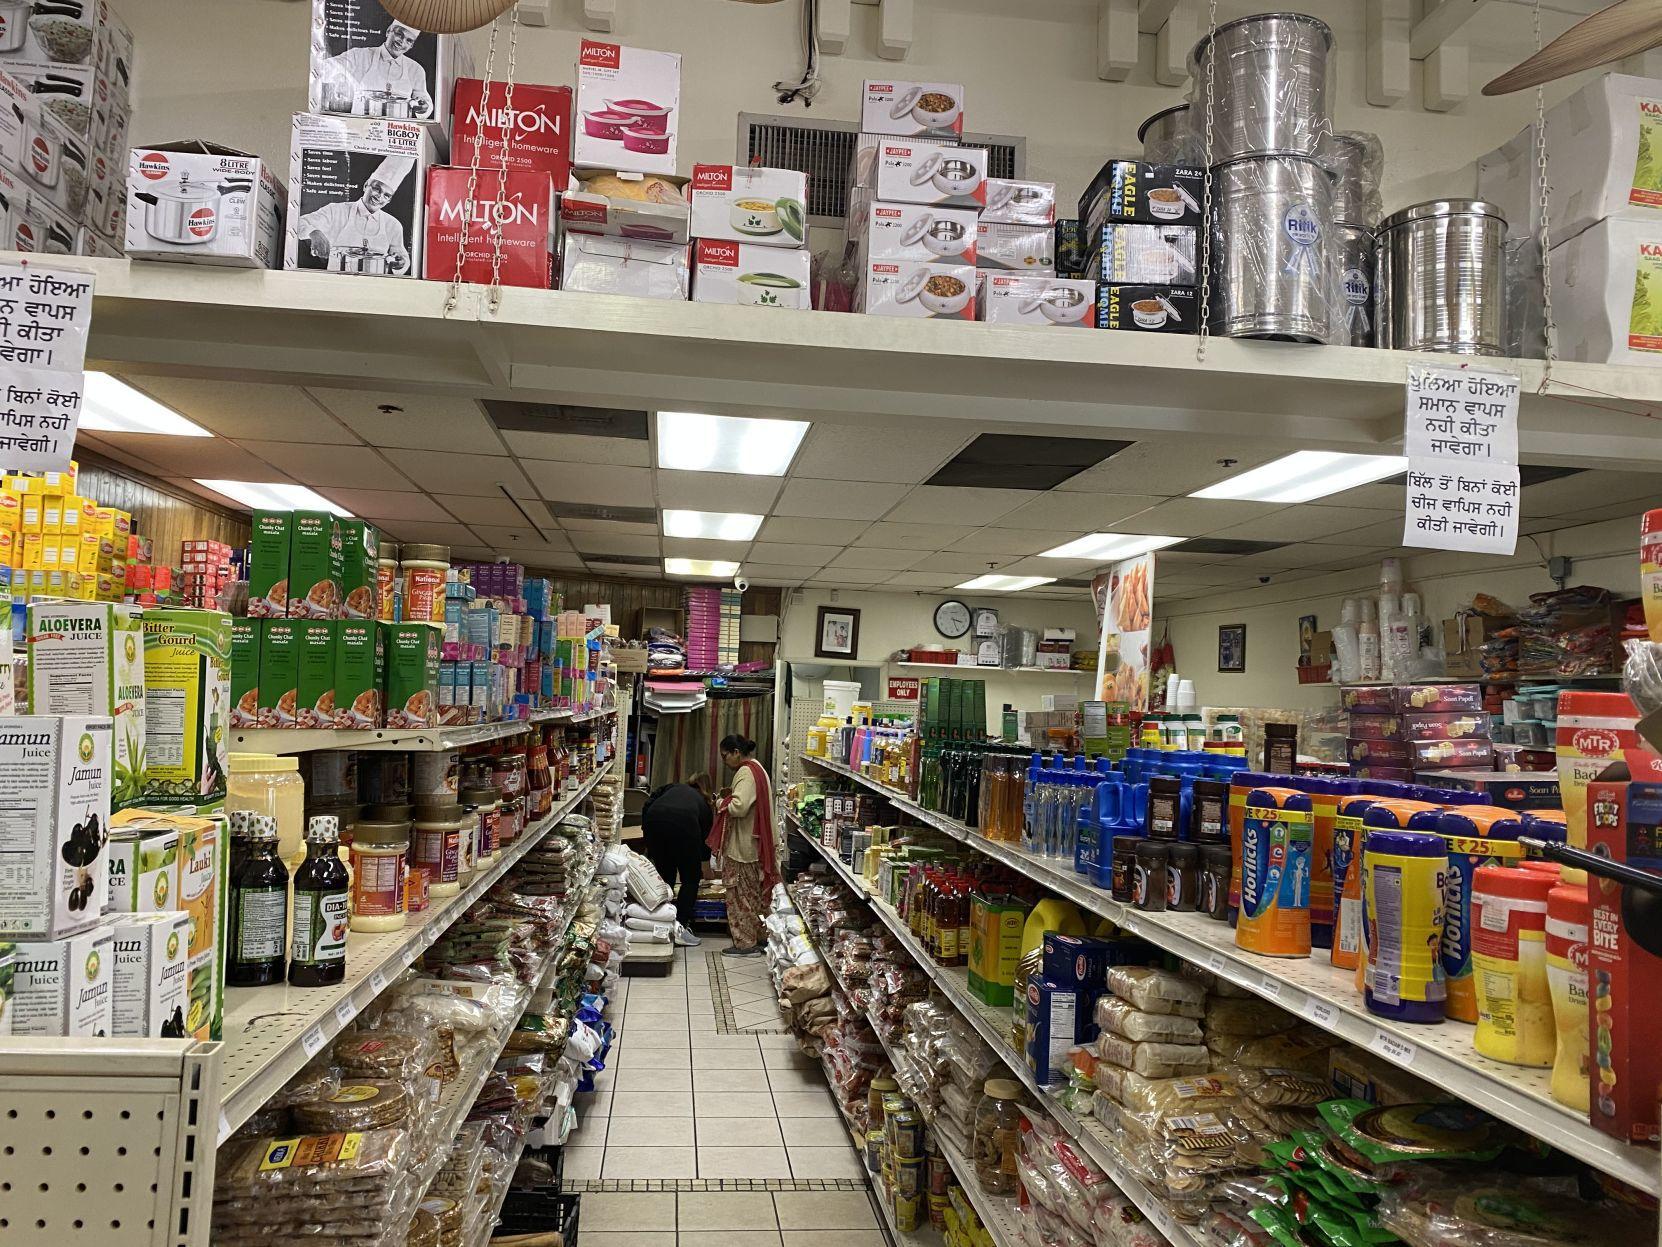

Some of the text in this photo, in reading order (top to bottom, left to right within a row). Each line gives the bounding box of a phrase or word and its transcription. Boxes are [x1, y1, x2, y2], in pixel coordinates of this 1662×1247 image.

[582, 47, 615, 58] MILTON
[387, 122, 421, 133] Hawkins
[466, 105, 560, 136] MILTON
[387, 130, 420, 139] BIGBOY
[511, 140, 559, 155] homeware
[139, 162, 170, 171] Hawkins
[220, 158, 249, 169] 8 LITRE
[212, 167, 256, 176] WIDE-BODY
[697, 172, 727, 180] MILTON
[1175, 168, 1193, 177] ZARA
[1111, 163, 1123, 216] HOME
[1123, 162, 1136, 216] EAGLE
[188, 218, 215, 227] Hawkins
[1288, 219, 1317, 234] Ritik
[466, 251, 491, 259] ORCHID
[704, 248, 735, 257] MILTON
[1114, 226, 1127, 281] EAGLE
[29, 274, 89, 299] ਹੋਇਆ
[24, 301, 77, 321] ਵਾਪਸ
[1110, 287, 1120, 329] EAGLE
[17, 320, 64, 342] ਕੀਤਾ
[1468, 377, 1518, 399] ਹੋਇਆ
[7, 385, 80, 409] ਬਿਨਾਂ ਕੋਈ
[1419, 396, 1506, 418] ਸਮਾਨ ਵਾਪਸ
[1460, 418, 1498, 437] ਕੀਤਾ
[1408, 472, 1518, 496] ਬਿੱਲ ਤੋਂ ਬਿਨਾਂ ਕੋਈ
[1411, 494, 1438, 510] ਚੀਜ
[1442, 498, 1482, 514] ਵਾਪਿਸ
[1417, 516, 1449, 532] ਕੀਤੀ
[415, 575, 440, 583] National
[39, 618, 101, 632] ALOEVERA
[143, 622, 175, 633] Bitter
[70, 633, 102, 641] JUICE
[158, 633, 196, 645] Gourd
[118, 685, 144, 700] ALOEVERA
[1459, 695, 1474, 703] Papdi
[0, 733, 51, 746] amun
[1579, 735, 1611, 751] MTR
[22, 747, 51, 759] Juice
[68, 766, 102, 786] Jamun
[1574, 768, 1598, 781] Bad
[89, 780, 102, 791] Juice
[1529, 785, 1549, 794] Soan
[1594, 801, 1619, 816] FROOT
[1595, 813, 1618, 827] LOOPS
[189, 853, 211, 874] Lauki
[1244, 828, 1258, 905] Horlicks
[1443, 865, 1463, 960] Horlicks
[1593, 920, 1618, 934] EVERY
[1593, 932, 1618, 949] BITE
[15, 959, 59, 973] mun
[114, 954, 142, 965] Juice
[29, 974, 59, 986] Juice
[158, 961, 185, 987] Jamun
[76, 980, 108, 1010] Jamun
